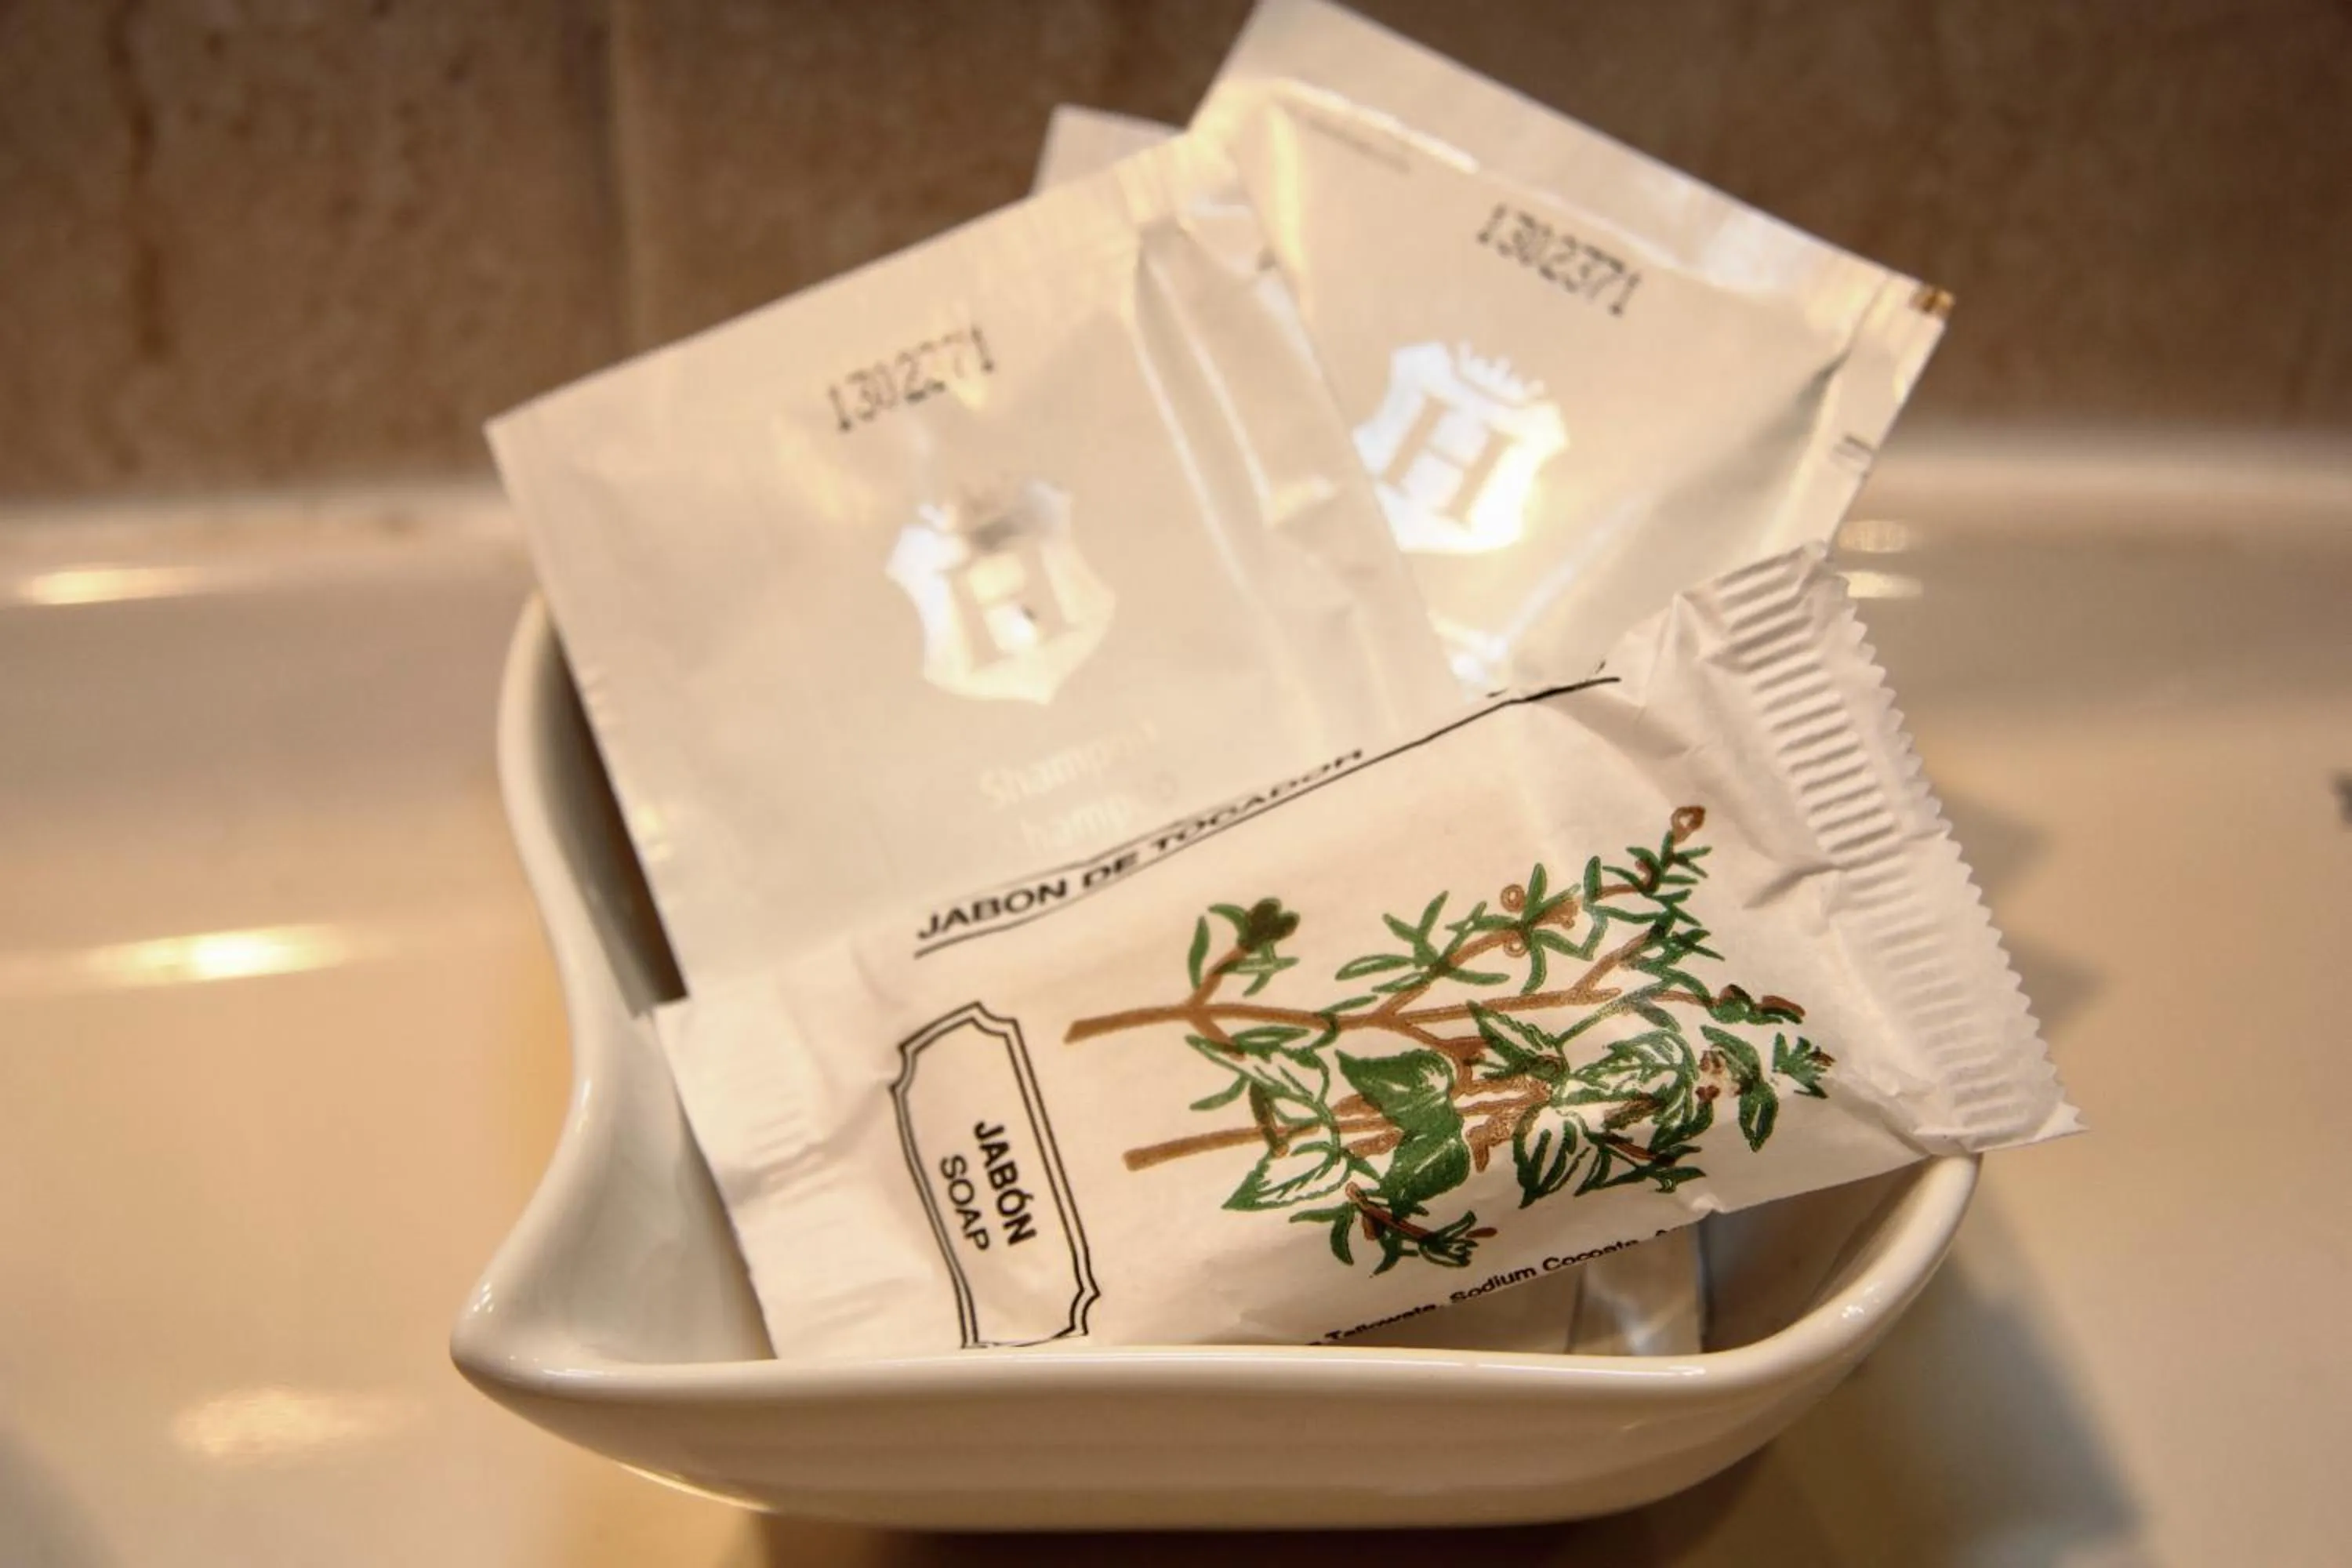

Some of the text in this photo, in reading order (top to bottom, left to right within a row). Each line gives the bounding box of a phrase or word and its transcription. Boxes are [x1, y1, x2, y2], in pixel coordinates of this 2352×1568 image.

[1476, 201, 1642, 318] 1302371
[978, 718, 1159, 812] Shampo
[916, 747, 1363, 940] JABON DE TOCADOR
[938, 1154, 990, 1251] SOAP
[974, 1120, 1037, 1247] JABÓN
[1450, 1265, 1537, 1303] Sodium
